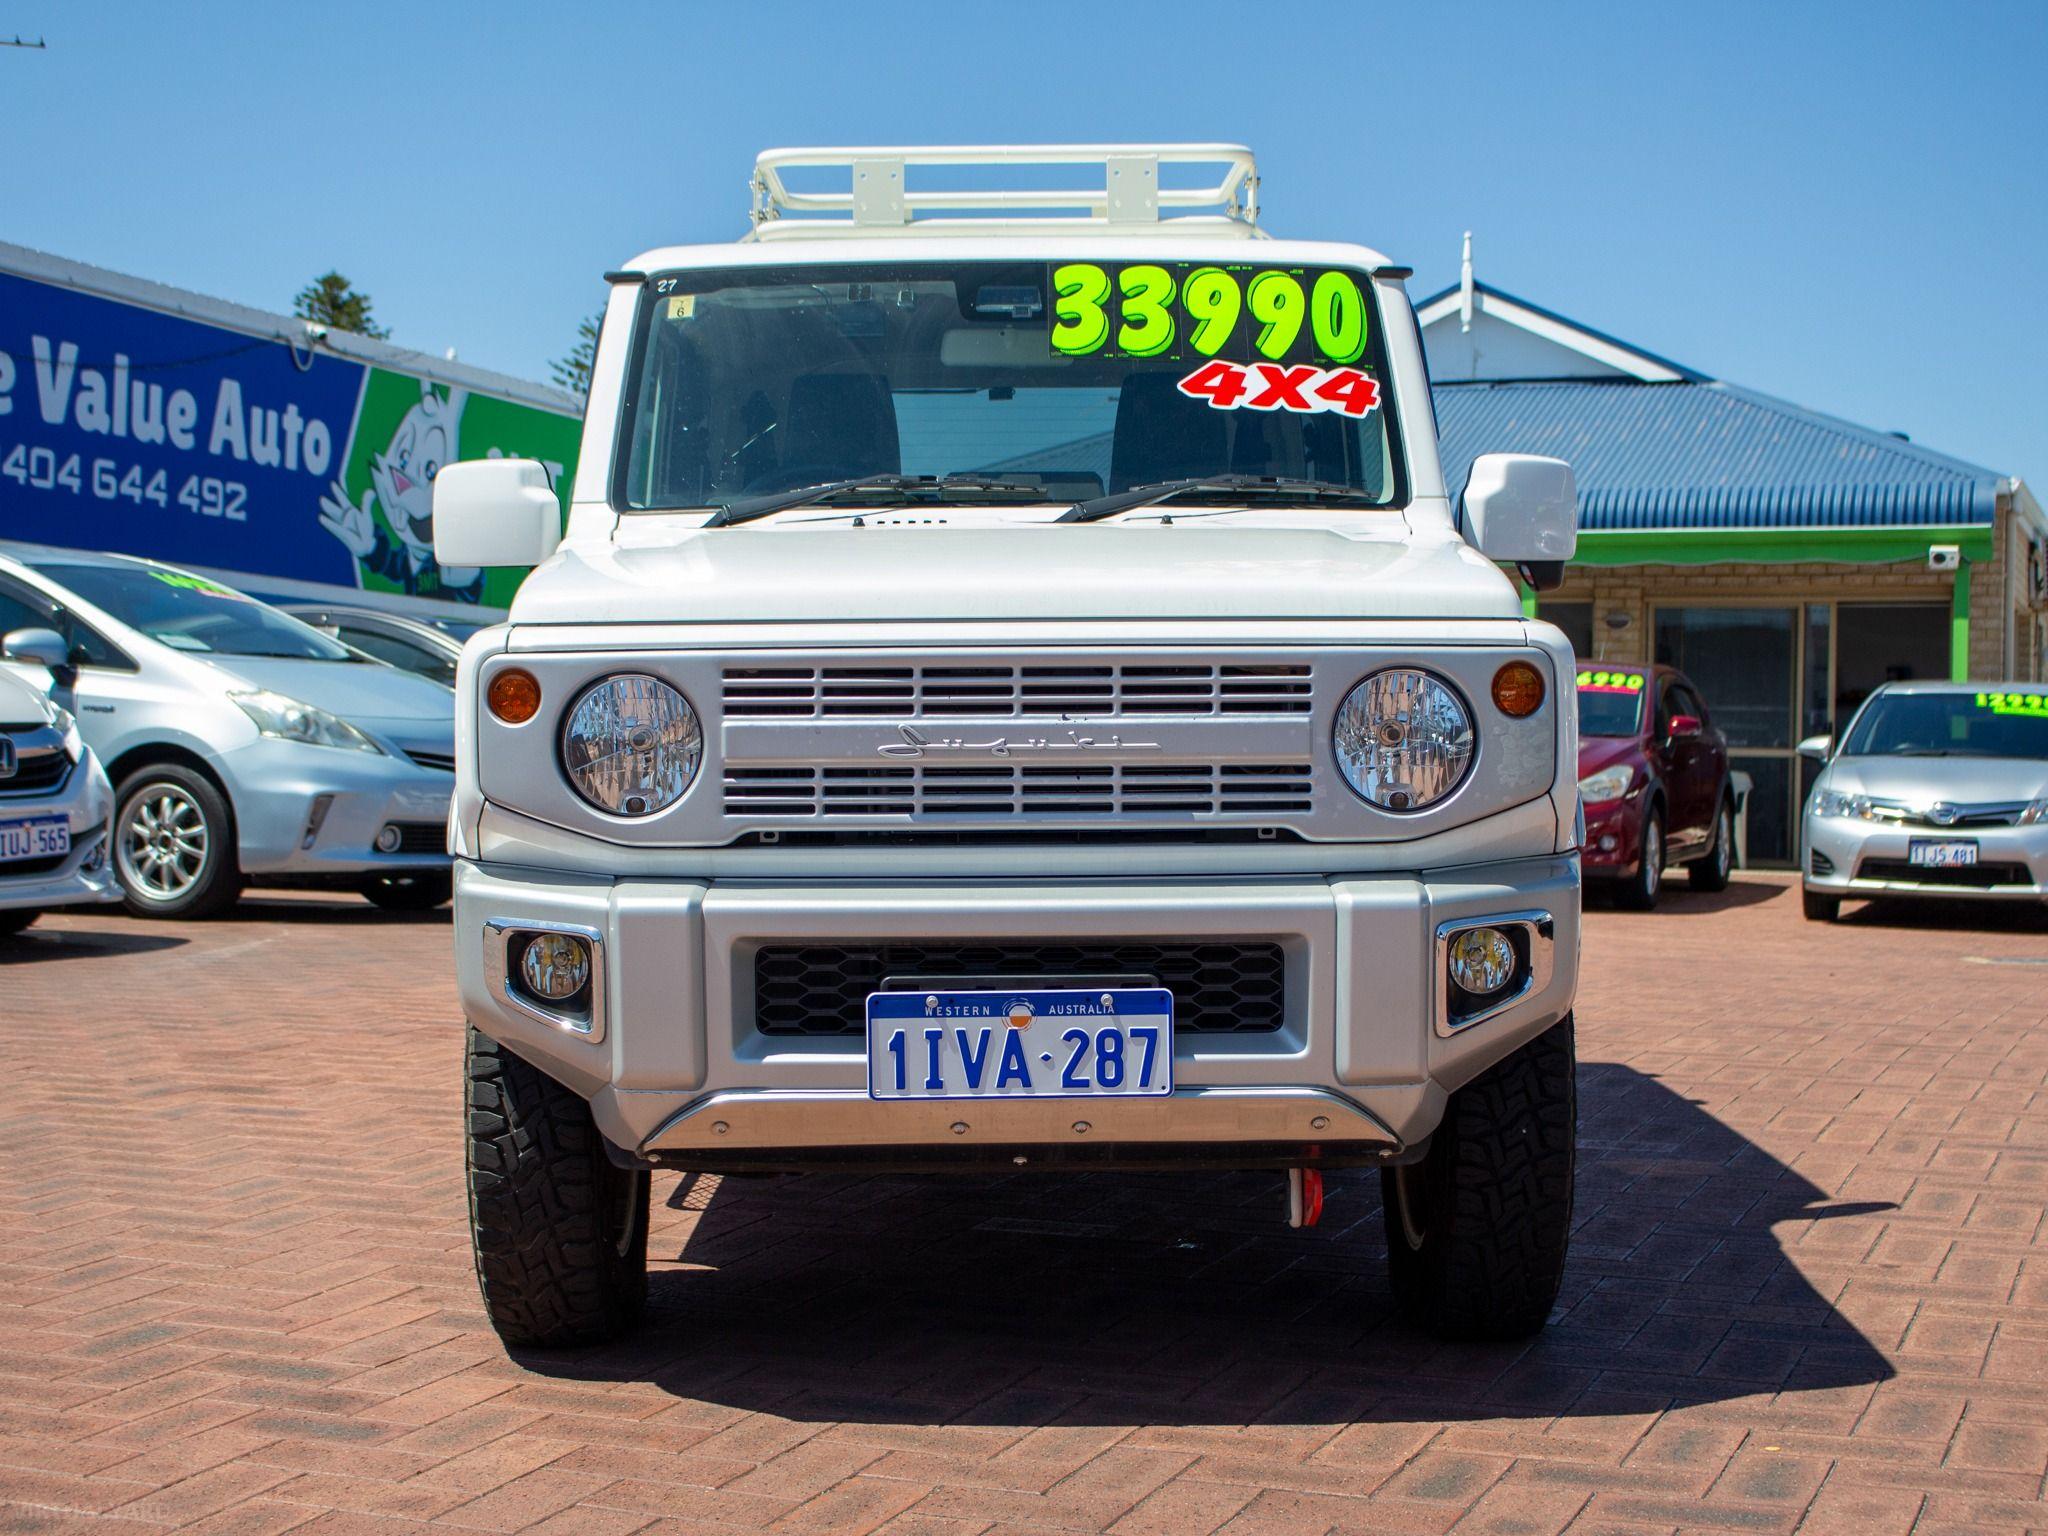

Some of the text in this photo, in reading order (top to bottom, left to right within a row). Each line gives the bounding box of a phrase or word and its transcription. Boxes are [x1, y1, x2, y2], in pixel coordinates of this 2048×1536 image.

[1051, 264, 1367, 363] 33990
[32, 334, 198, 450] Value
[209, 377, 331, 476] Auto
[93, 458, 168, 508] 644
[178, 474, 247, 521] 492
[925, 1004, 1114, 1016] WESTERN AUSTRALIA
